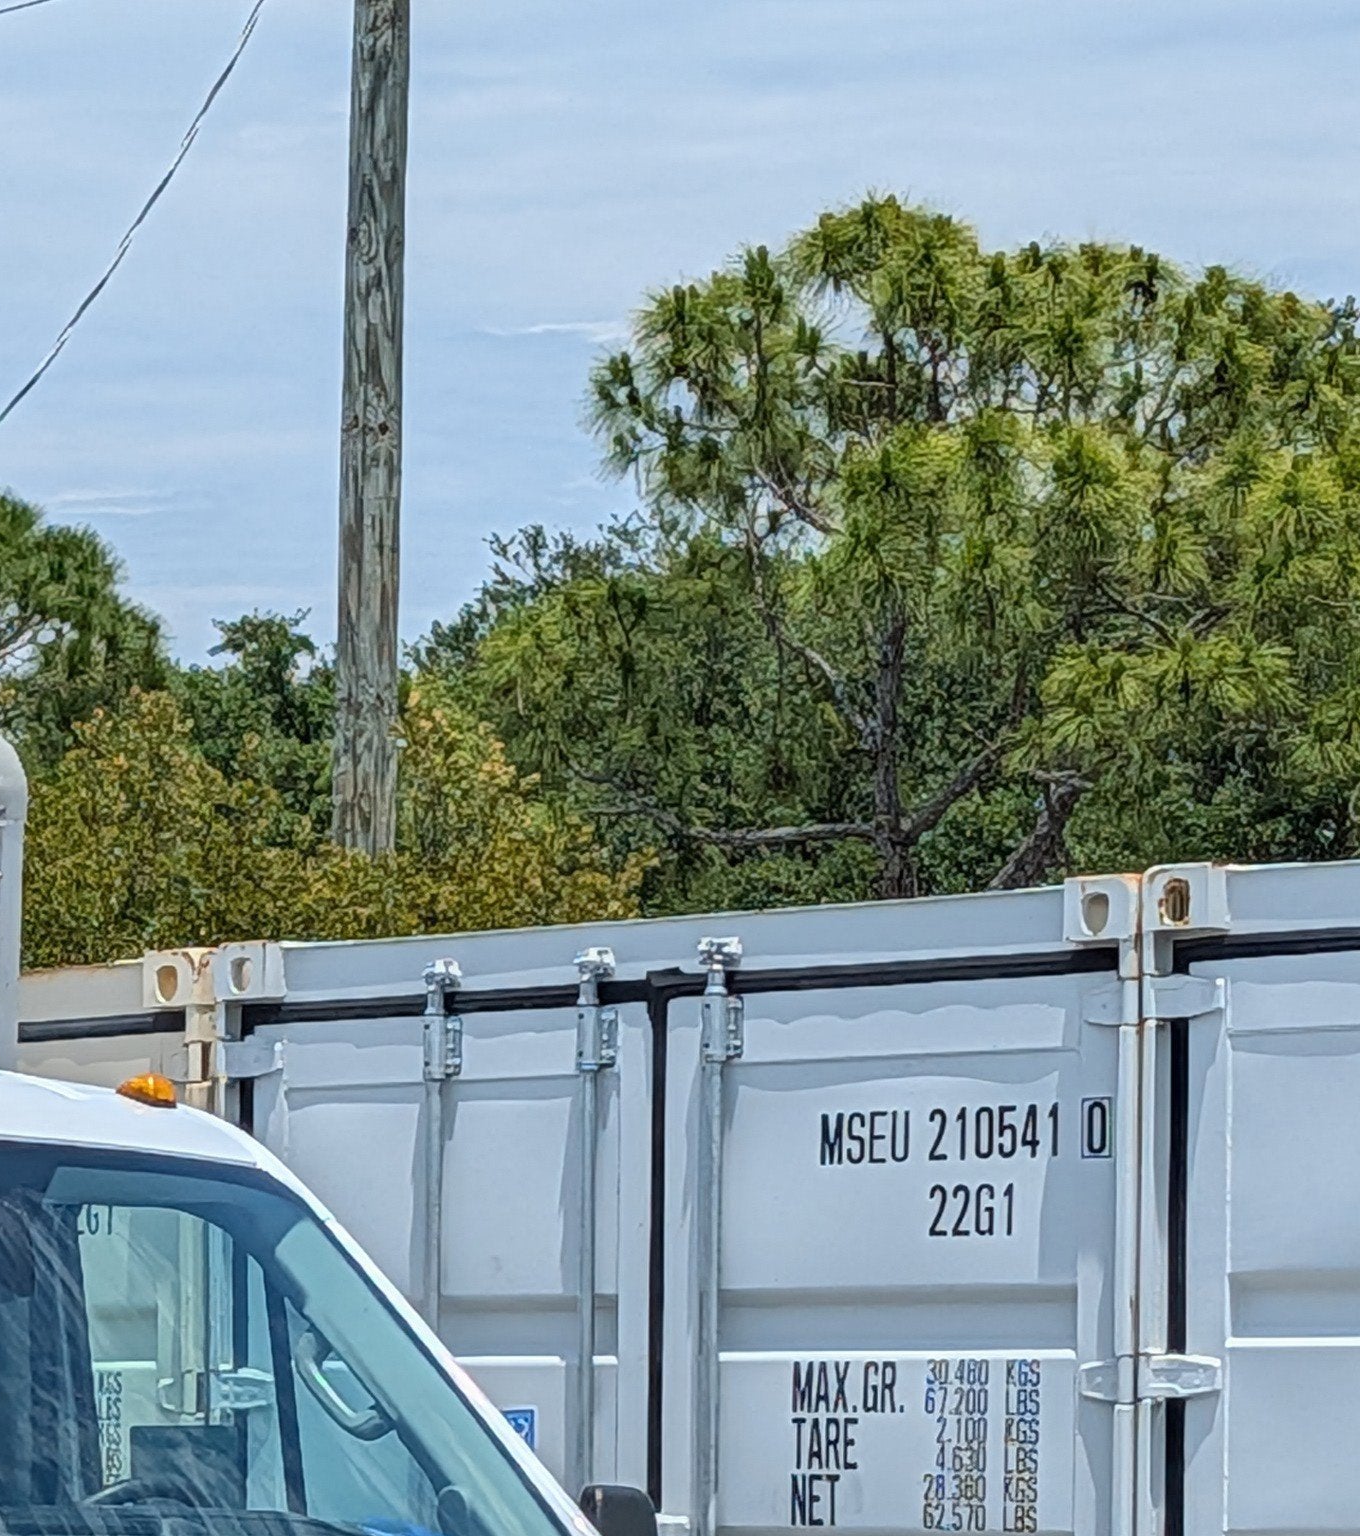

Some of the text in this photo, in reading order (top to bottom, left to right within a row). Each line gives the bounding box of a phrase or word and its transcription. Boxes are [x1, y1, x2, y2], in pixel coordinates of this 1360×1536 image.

[820, 1100, 1107, 1165] MSEU 210541 0
[928, 1183, 1014, 1236] 22G1
[791, 1360, 905, 1413] MAX.GR.
[1005, 1359, 1041, 1388] KGS
[924, 1387, 1040, 1416] 67.200 LBS
[791, 1415, 1040, 1470] TARE 2.100 KGS
[935, 1446, 1039, 1475] 4.630 LBS
[790, 1473, 841, 1527] NET
[1003, 1475, 1038, 1503] KGS
[922, 1502, 1038, 1533] 62.570 LBS
